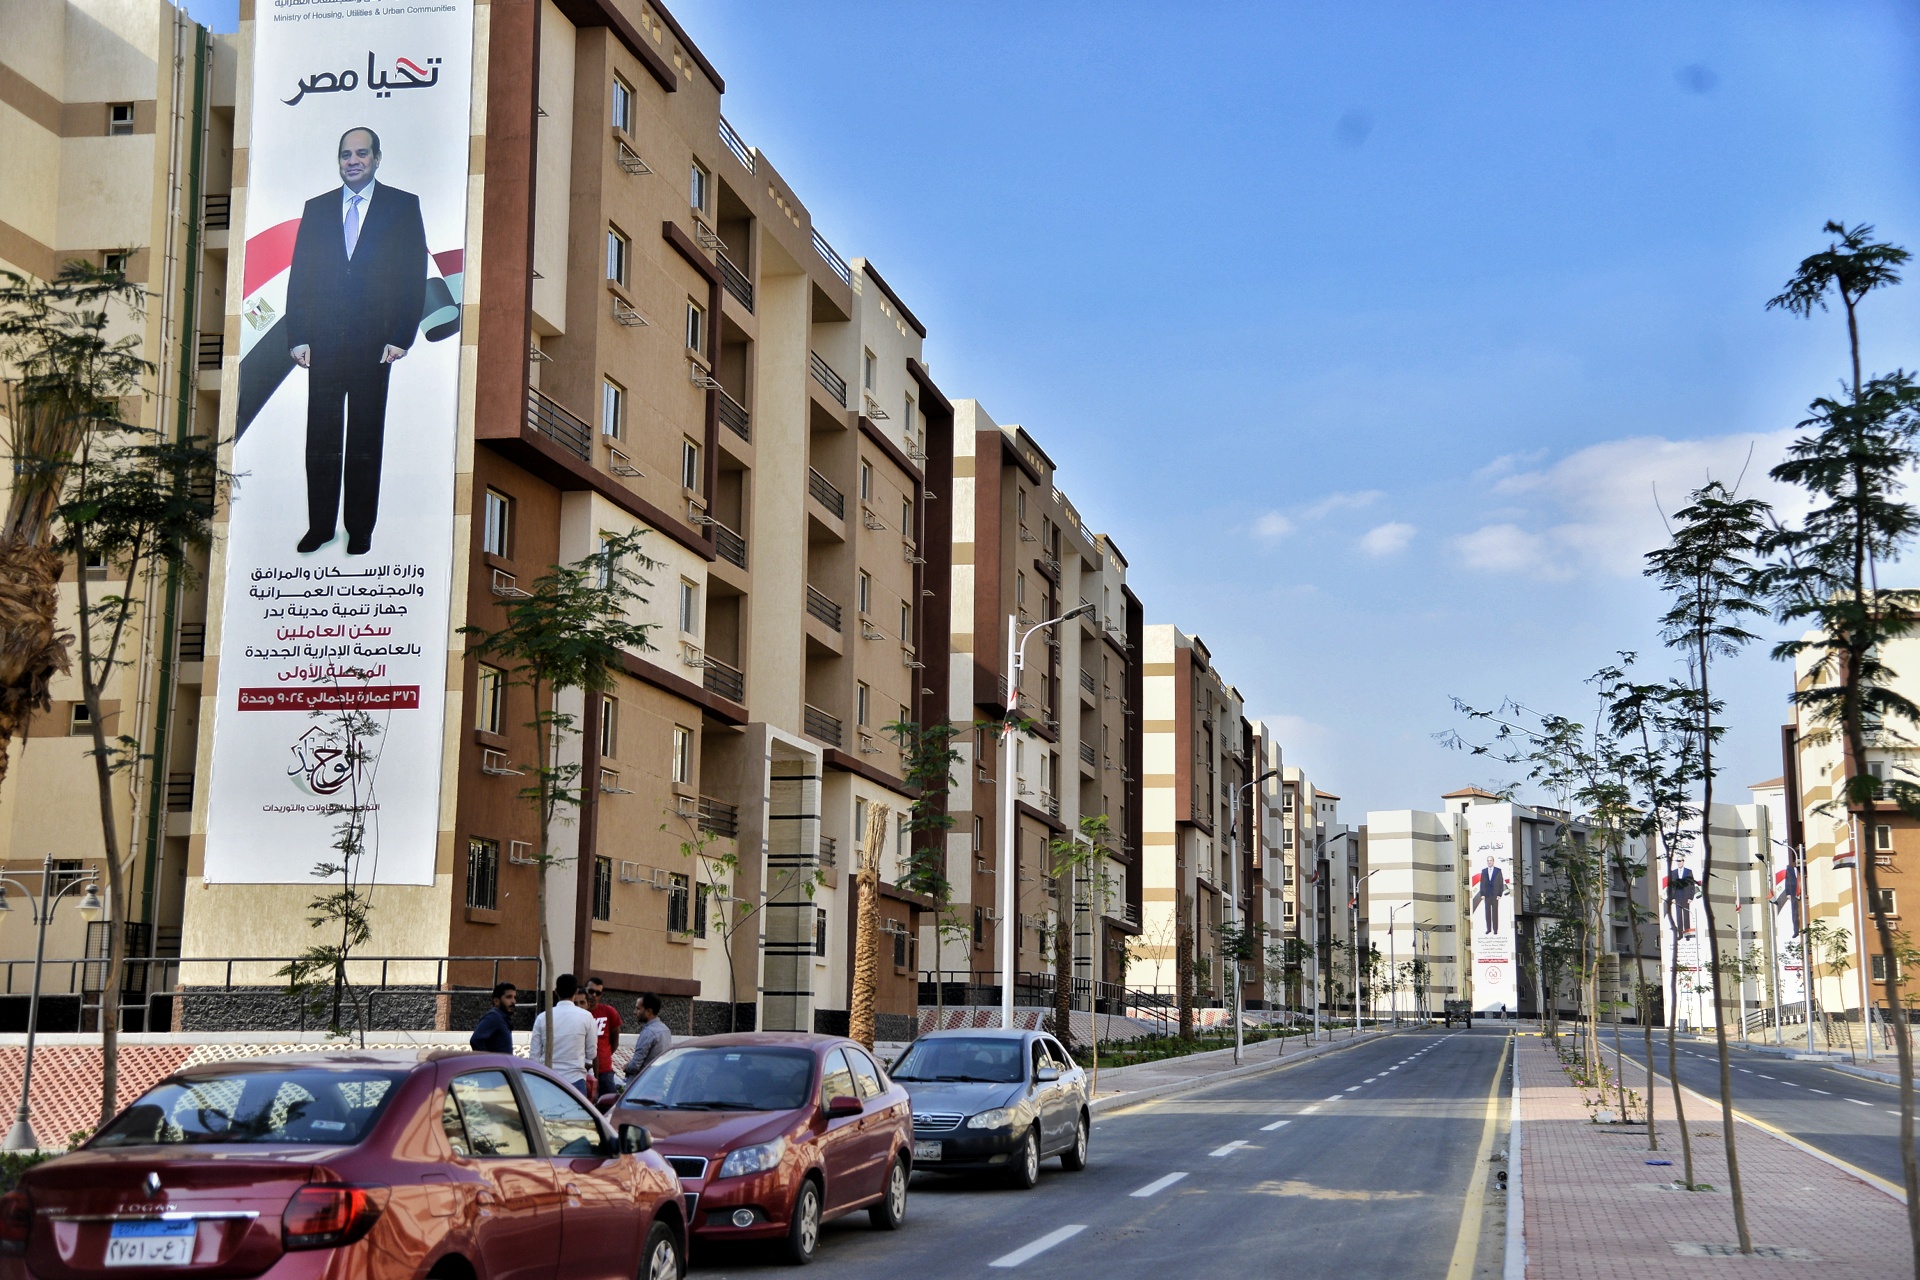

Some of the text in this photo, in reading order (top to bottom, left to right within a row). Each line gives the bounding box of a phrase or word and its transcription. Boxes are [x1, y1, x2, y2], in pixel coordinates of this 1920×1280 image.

[273, 14, 302, 22] Ministry
[303, 12, 311, 20] of
[312, 11, 344, 19] Housing,
[346, 9, 373, 17] Utilities
[382, 7, 405, 15] Urban
[407, 5, 456, 14] Communities
[280, 50, 442, 106] تحيا مصر
[251, 564, 425, 581] وزارة الإسكان والمرافق
[249, 583, 424, 600] والمجتمعات العمرانية
[264, 603, 408, 619] جهاز تنمية مدينة بدر
[276, 624, 392, 640] سكن العاملين
[245, 643, 422, 660] بالعاصمة الإدارية الجديدة
[278, 663, 322, 681] الأولى
[241, 692, 274, 705] وحدة
[277, 692, 304, 704] ٩٠٢٤
[357, 691, 390, 703] عمارة
[392, 690, 417, 701] ٣٧٦
[262, 804, 305, 813] والتوريدات
[118, 1203, 178, 1212] LOGAN
